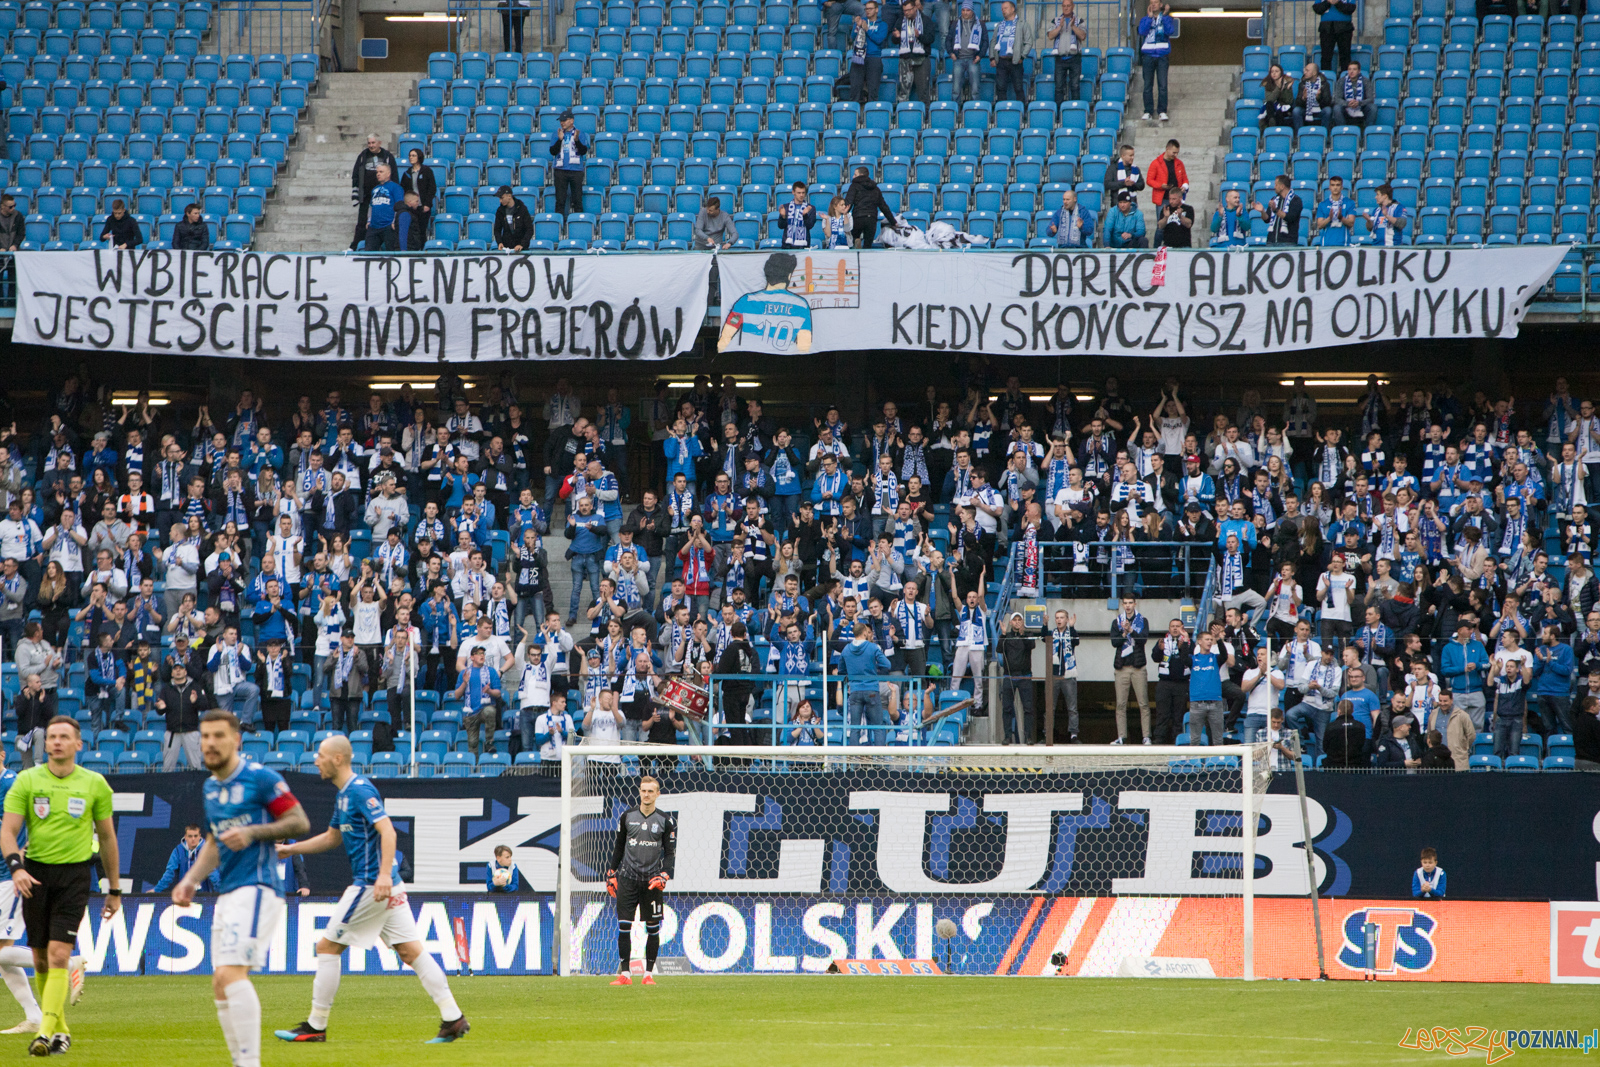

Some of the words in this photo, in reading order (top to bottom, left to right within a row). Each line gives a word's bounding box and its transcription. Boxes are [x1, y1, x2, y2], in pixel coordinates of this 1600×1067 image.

[94, 249, 328, 302] WYBIERACIE
[352, 253, 575, 305] TRENERÓW
[1189, 248, 1452, 297] ALKOHOLIKU
[297, 302, 449, 363] BANDA
[470, 297, 684, 360] FRAJERÓW
[756, 318, 795, 352] 10
[892, 302, 992, 351] KIEDY
[1000, 299, 1247, 352] SKOŃCZYSZ
[1263, 296, 1313, 348] NA
[1030, 614, 1041, 623] F1
[1414, 699, 1427, 709] STS
[384, 790, 1328, 896] KLUB
[638, 840, 658, 848] AFORTI
[1336, 907, 1437, 974] STS
[847, 962, 871, 975] STS
[878, 962, 902, 975] STS
[910, 962, 934, 975] STS
[1165, 963, 1198, 975] AFORTI
